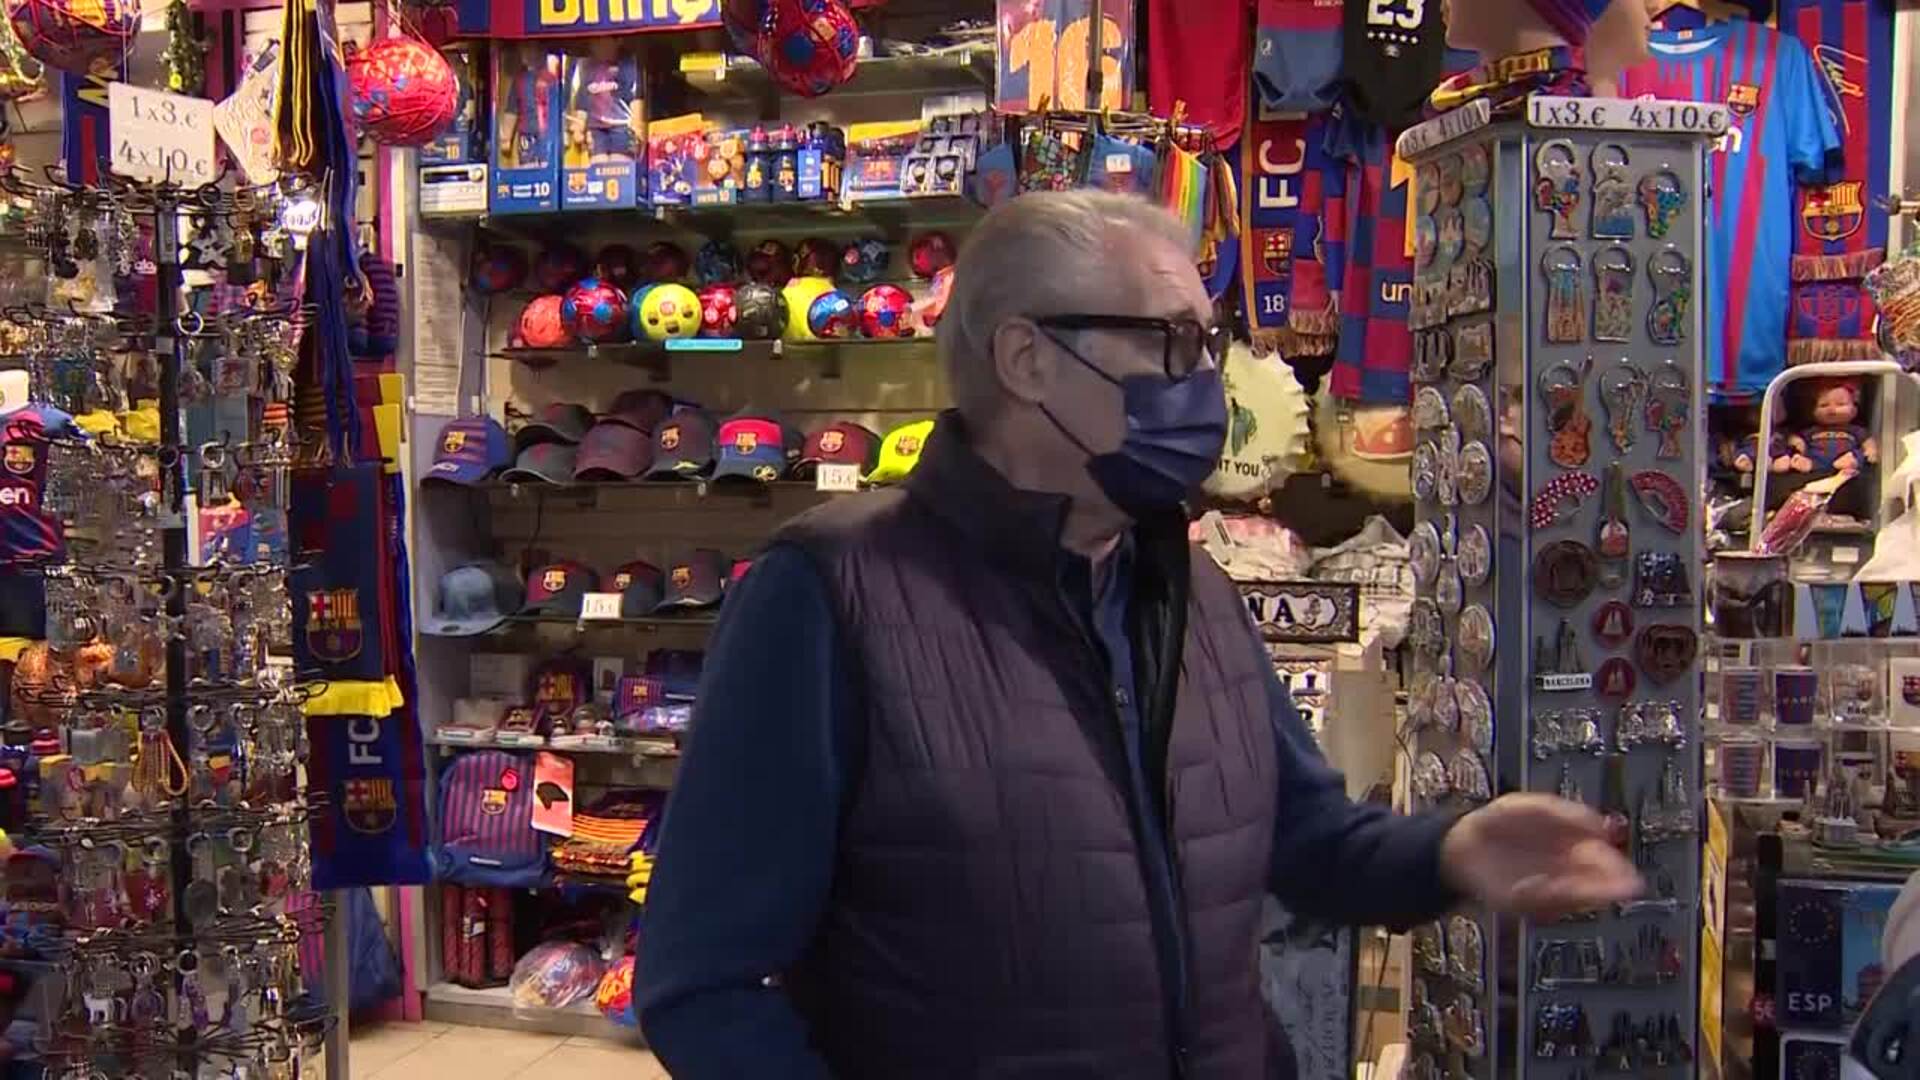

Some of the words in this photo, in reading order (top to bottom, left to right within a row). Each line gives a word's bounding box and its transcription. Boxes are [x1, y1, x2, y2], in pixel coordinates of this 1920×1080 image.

[1367, 0, 1424, 29] 23
[1259, 138, 1306, 208] FC
[1263, 294, 1285, 313] 18
[1234, 462, 1259, 477] YOU
[347, 717, 382, 764] FC
[1788, 993, 1832, 1012] ESP
